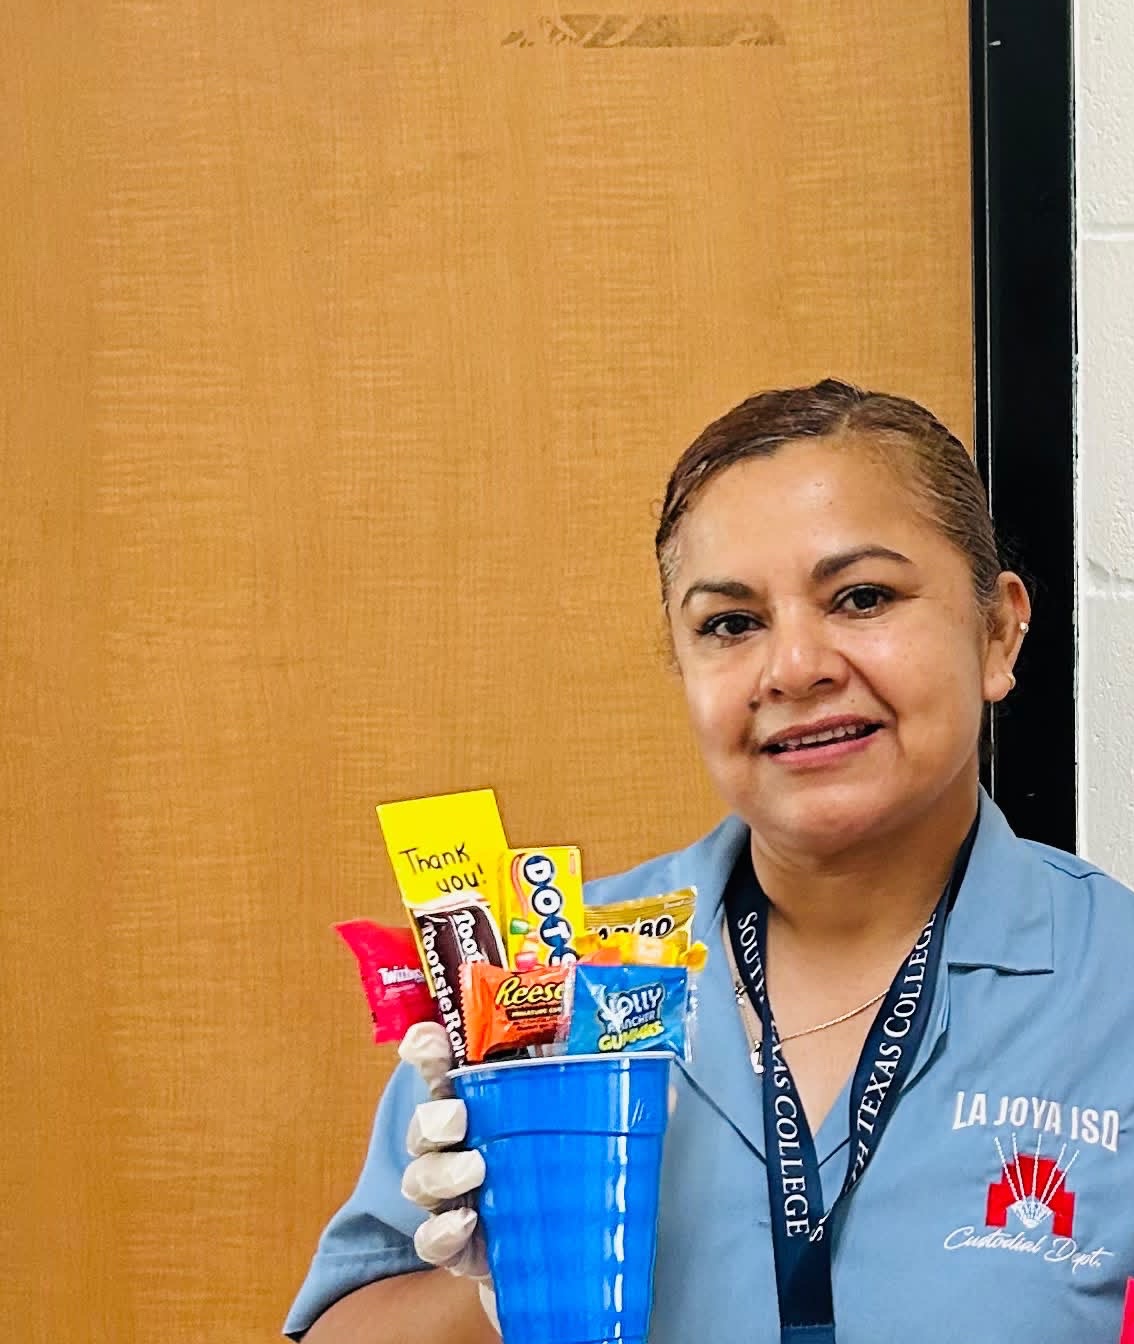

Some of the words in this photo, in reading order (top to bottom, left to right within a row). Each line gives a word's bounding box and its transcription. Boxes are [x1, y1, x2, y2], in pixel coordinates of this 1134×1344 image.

[399, 843, 470, 875] Thank
[436, 863, 487, 893] you!
[857, 1042, 903, 1135] TEXAS
[952, 1091, 987, 1130] LA
[993, 1096, 1062, 1135] JOYA
[1071, 1106, 1120, 1153] ISD
[775, 1095, 810, 1238] COLLEGE
[943, 1225, 1048, 1254] Custodial
